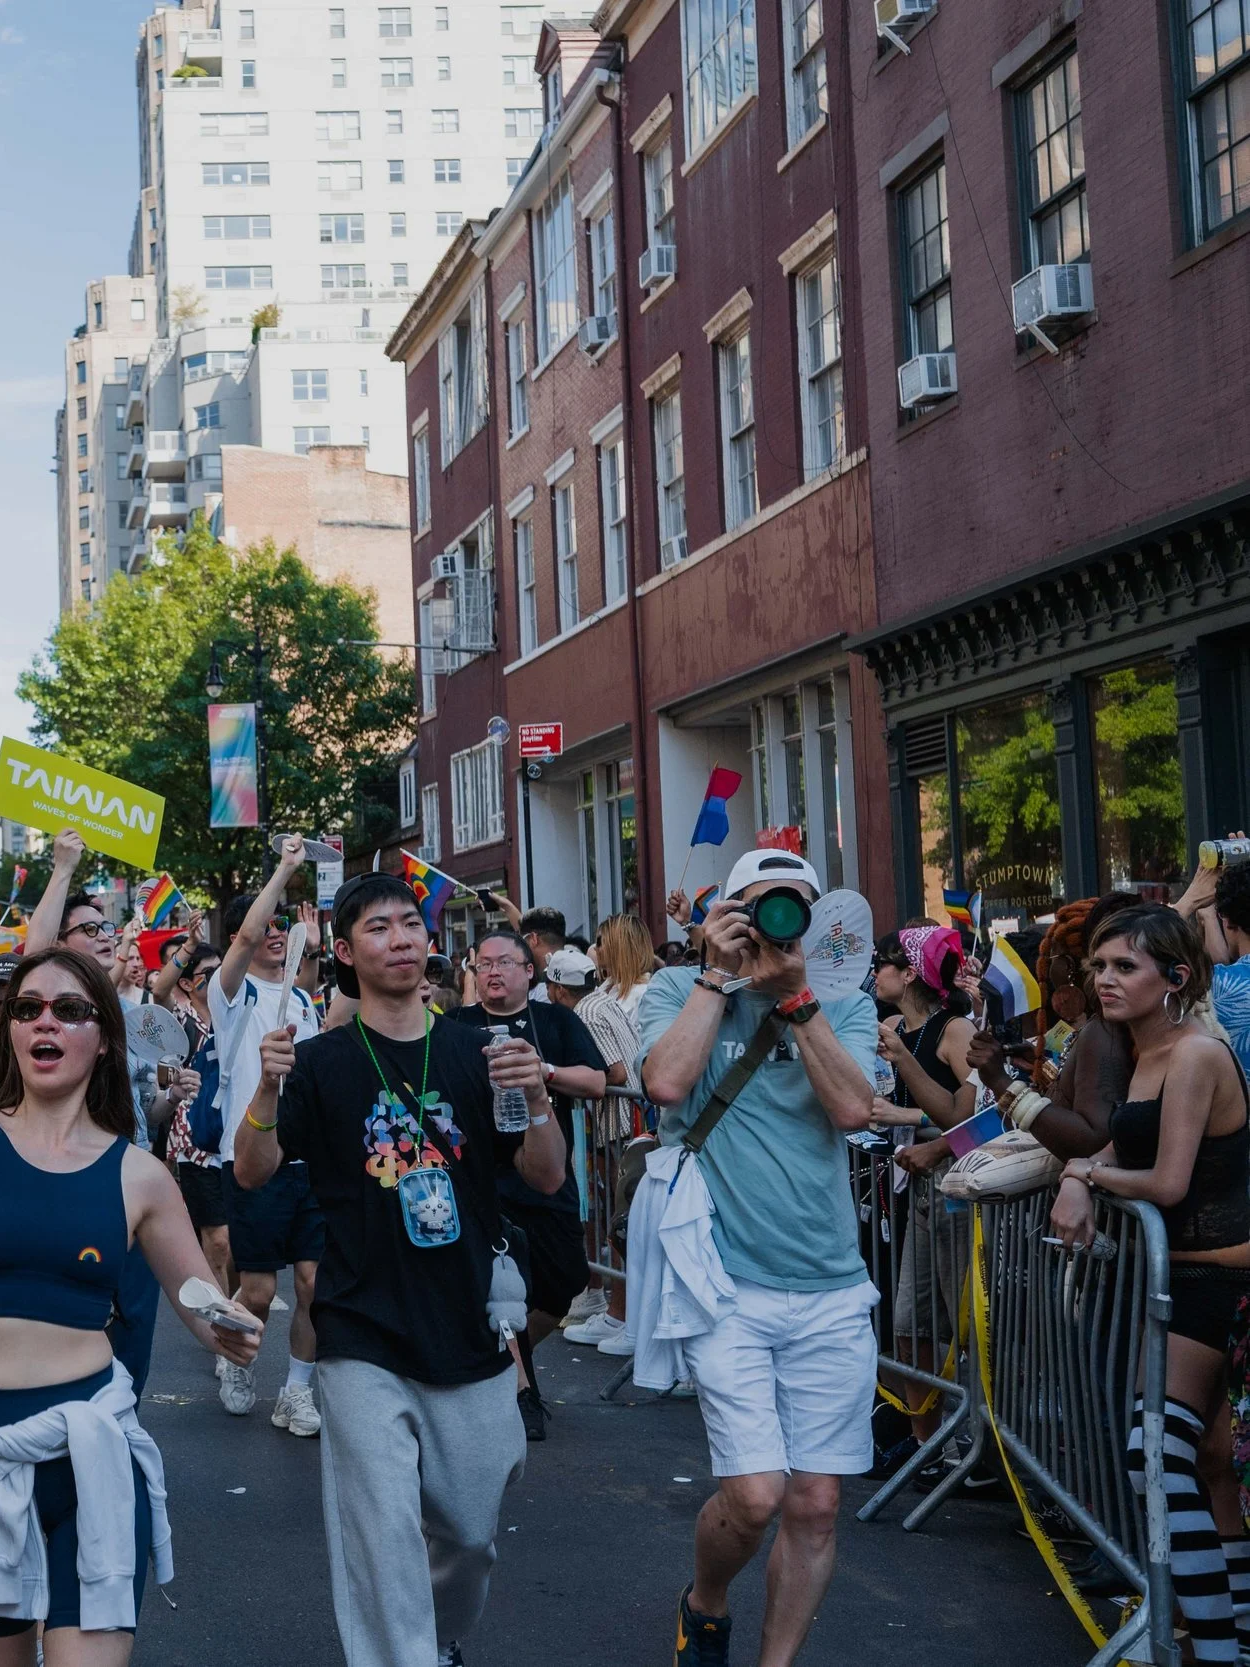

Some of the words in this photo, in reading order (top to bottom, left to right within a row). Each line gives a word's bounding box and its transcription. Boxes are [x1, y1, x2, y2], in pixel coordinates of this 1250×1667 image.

[522, 728, 529, 736] NO
[530, 726, 555, 736] STANDING
[522, 735, 543, 744] Anytime
[7, 758, 156, 835] TAIWAN
[32, 799, 66, 818] WAVES
[67, 812, 82, 823] OF
[83, 817, 125, 841] WONDER
[975, 864, 1054, 891] STUMPTOWN
[1011, 895, 1054, 909] ROASTERS
